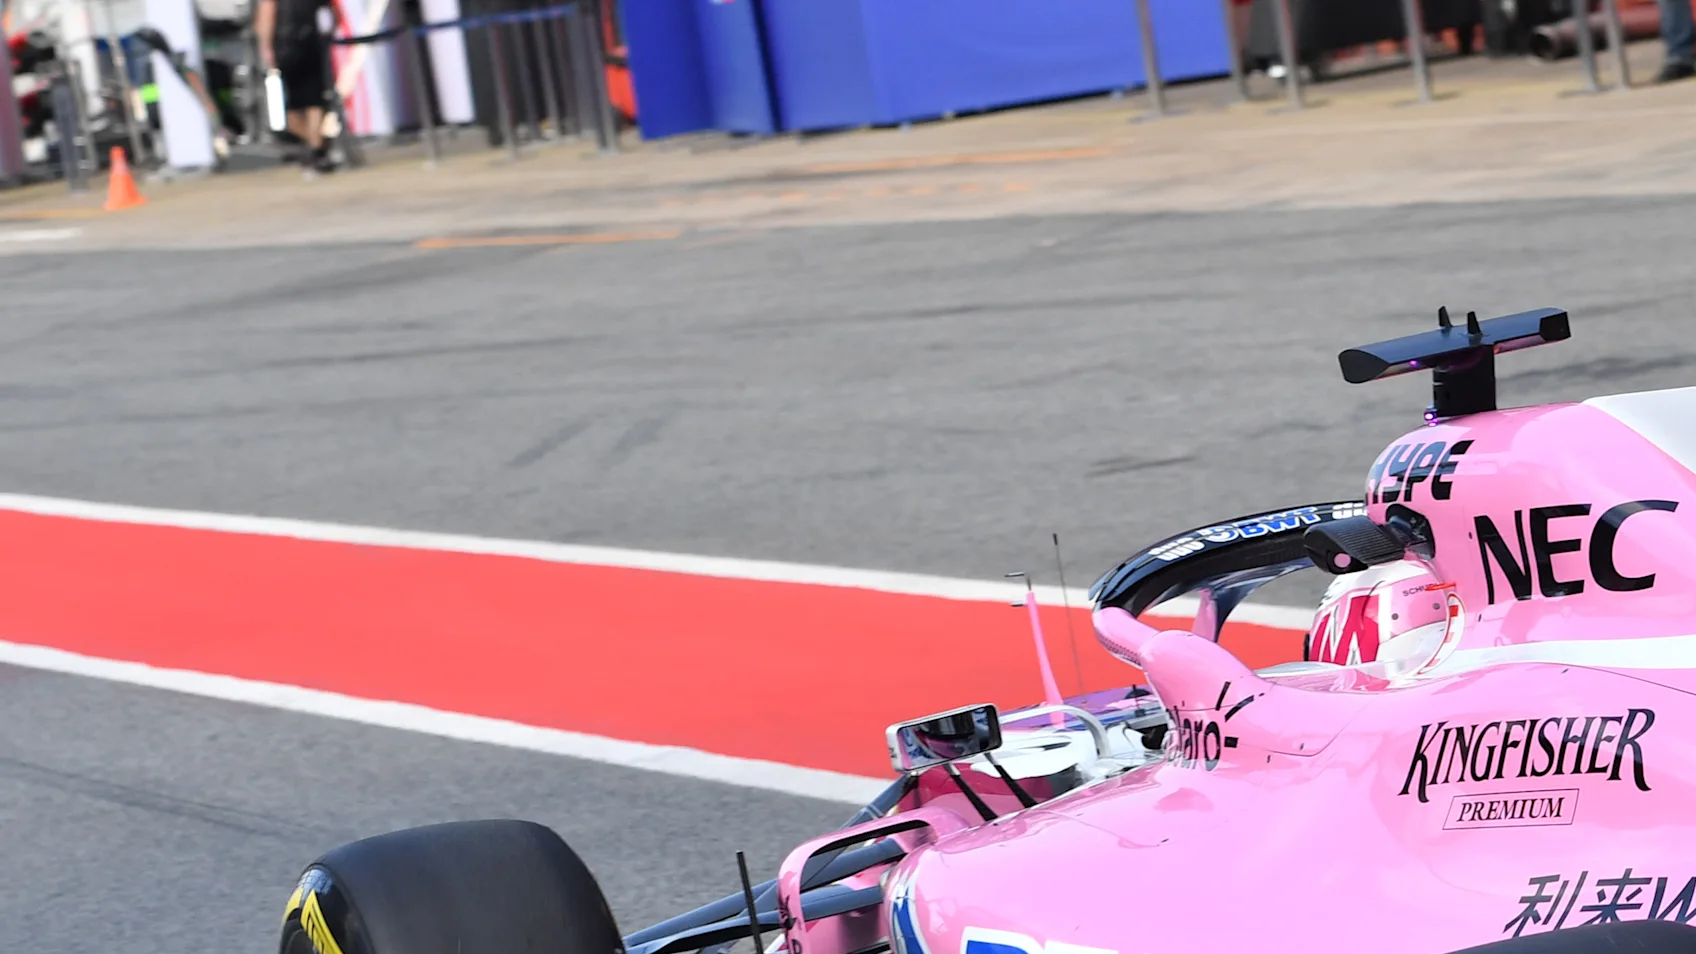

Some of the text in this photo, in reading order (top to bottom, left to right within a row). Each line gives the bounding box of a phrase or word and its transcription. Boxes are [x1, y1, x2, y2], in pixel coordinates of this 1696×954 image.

[1365, 439, 1475, 506] HYPE
[1473, 499, 1679, 605] NEC
[1399, 707, 1657, 804] KINGFISHER
[1456, 796, 1566, 823] PREMIUM
